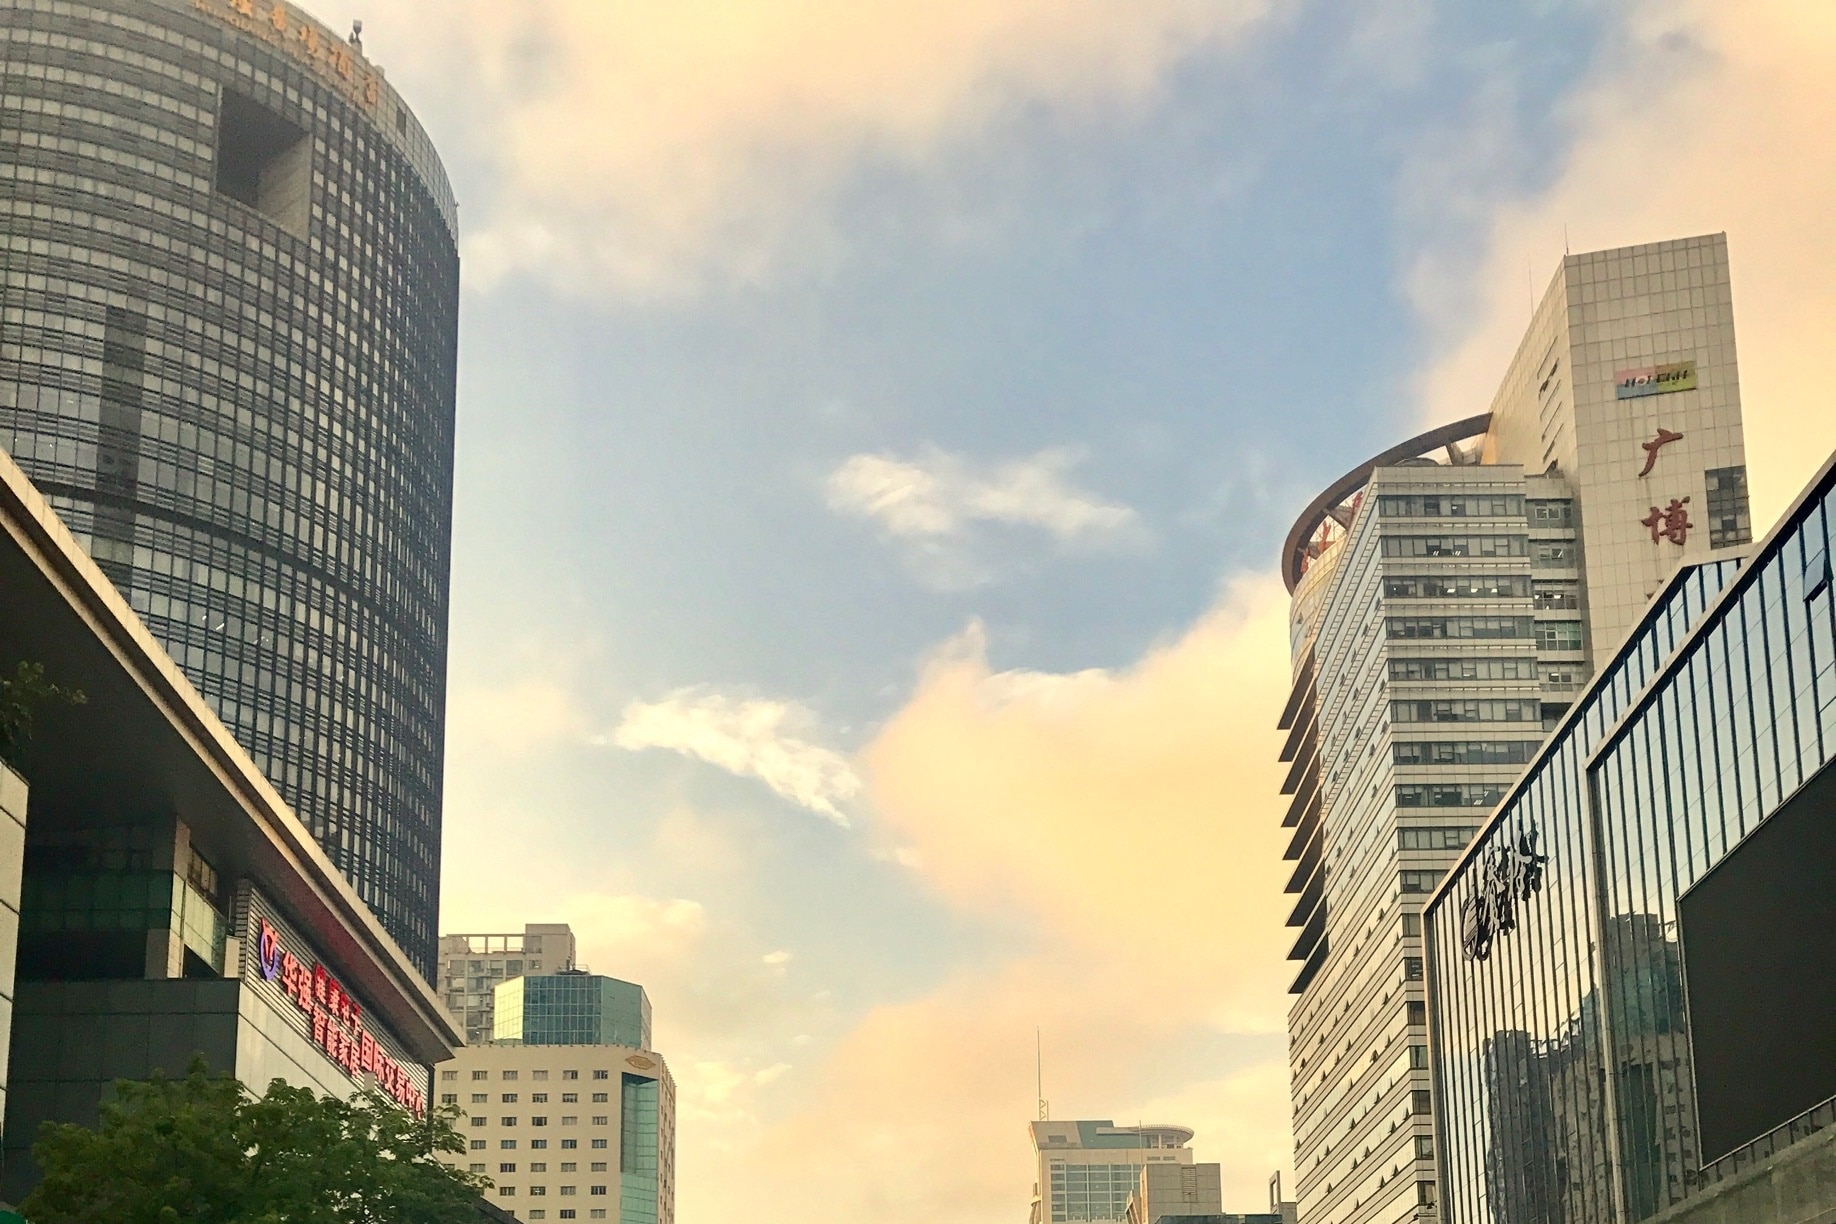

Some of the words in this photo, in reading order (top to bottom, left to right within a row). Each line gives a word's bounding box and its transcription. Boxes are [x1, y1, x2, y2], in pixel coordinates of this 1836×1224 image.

[281, 950, 314, 1015] 华强
[312, 1003, 363, 1081] 智能家居
[361, 1028, 427, 1121] 国际交易中心
